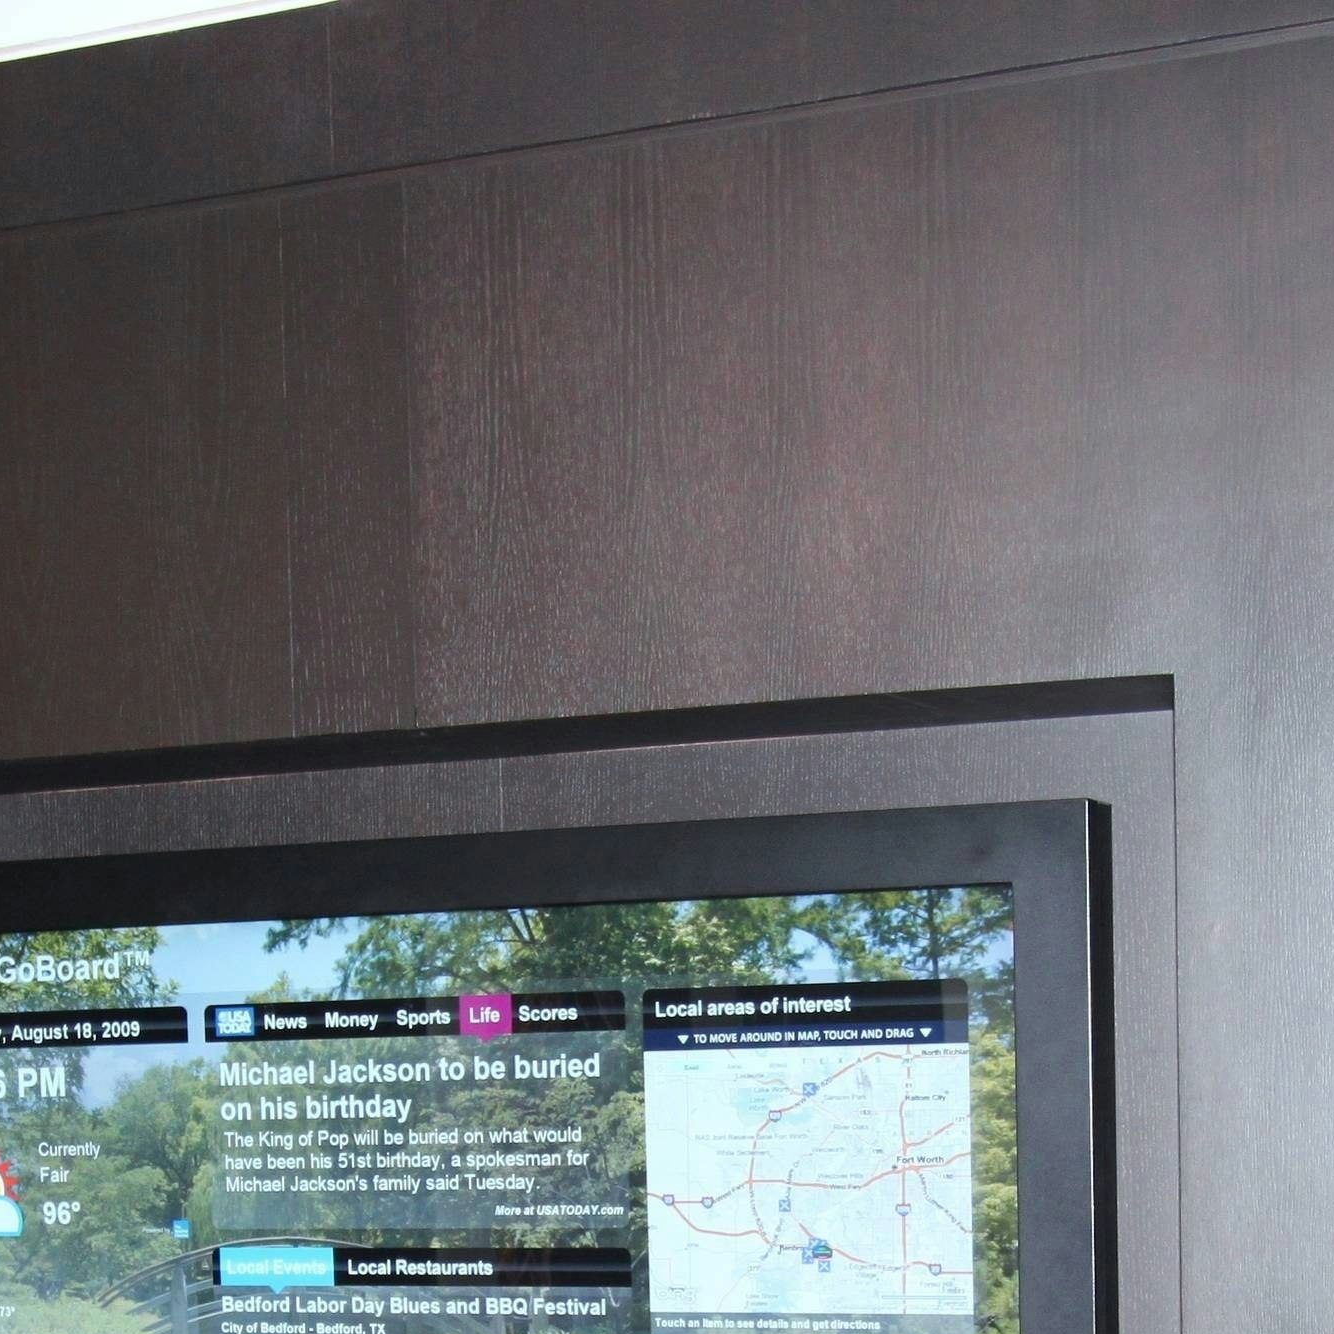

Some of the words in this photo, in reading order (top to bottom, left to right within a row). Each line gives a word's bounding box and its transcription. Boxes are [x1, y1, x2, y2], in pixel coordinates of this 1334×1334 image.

[228, 1010, 250, 1022] USA
[654, 1000, 702, 1018] Local
[707, 1002, 755, 1016] areas
[760, 997, 779, 1014] of
[783, 996, 851, 1013] interest
[264, 1014, 307, 1030] News
[325, 1012, 378, 1031] Money
[397, 1009, 450, 1029] Sports
[469, 1007, 500, 1023] Life
[519, 1005, 578, 1021] Scores
[12, 1023, 68, 1044] August
[74, 1022, 97, 1041] 18,
[102, 1021, 140, 1039] 2009
[694, 1034, 707, 1044] TO
[710, 1033, 737, 1043] MOVE
[740, 1032, 782, 1043] AROUND
[785, 1031, 795, 1041] IN
[797, 1031, 821, 1042] MAP,
[823, 1030, 858, 1040] TOUCH
[861, 1029, 883, 1039] AND
[886, 1028, 914, 1038] DRAG
[220, 1060, 314, 1087] Michael
[323, 1057, 431, 1085] Jackson
[438, 1057, 465, 1081] to
[473, 1056, 506, 1080] be
[514, 1053, 600, 1079] buried
[18, 1067, 66, 1098] PM
[221, 1102, 251, 1121] on
[261, 1096, 297, 1120] his
[306, 1094, 412, 1123] birthday
[224, 1132, 253, 1147] The
[259, 1131, 292, 1150] King
[298, 1131, 313, 1146] of
[318, 1131, 349, 1149] Pop
[354, 1130, 378, 1146] will
[384, 1130, 403, 1145] be
[409, 1128, 458, 1144] buried
[464, 1131, 484, 1144] on
[489, 1128, 528, 1144] what
[533, 1126, 582, 1143] would
[38, 1142, 100, 1159] Currently
[225, 1155, 262, 1170] have
[267, 1154, 305, 1169] been
[310, 1153, 332, 1169] his
[338, 1152, 371, 1169] 51st
[377, 1152, 445, 1170] birthday,
[451, 1154, 461, 1167] a
[466, 1151, 561, 1170] spokesman
[567, 1150, 589, 1166] for
[896, 1155, 913, 1164] Fort
[916, 1155, 944, 1164] Worth
[40, 1166, 70, 1182] Fair
[226, 1176, 285, 1192] Michael
[290, 1175, 367, 1192] Jackson's
[373, 1175, 420, 1194] family
[426, 1175, 459, 1190] said
[464, 1174, 540, 1193] Tuesday.
[43, 1201, 81, 1225] 96°
[495, 1205, 521, 1216] More
[524, 1206, 535, 1216] at
[536, 1205, 624, 1216] USATODAY.com
[227, 1260, 268, 1275] Local
[273, 1260, 326, 1275] Events
[348, 1259, 391, 1275] Local
[396, 1259, 493, 1276] Restaurants
[222, 1296, 290, 1313] Bedford
[295, 1296, 347, 1313] Labor
[352, 1296, 385, 1317] Day
[390, 1297, 440, 1314] Blues
[446, 1298, 479, 1315] and
[486, 1297, 527, 1316] BBQ
[534, 1298, 606, 1315] Festival
[221, 1322, 243, 1334] City
[261, 1323, 306, 1334] Bedford
[370, 1323, 386, 1334] TX
[655, 1317, 685, 1328] Touch
[757, 1319, 789, 1329] details
[830, 1320, 881, 1330] directions
